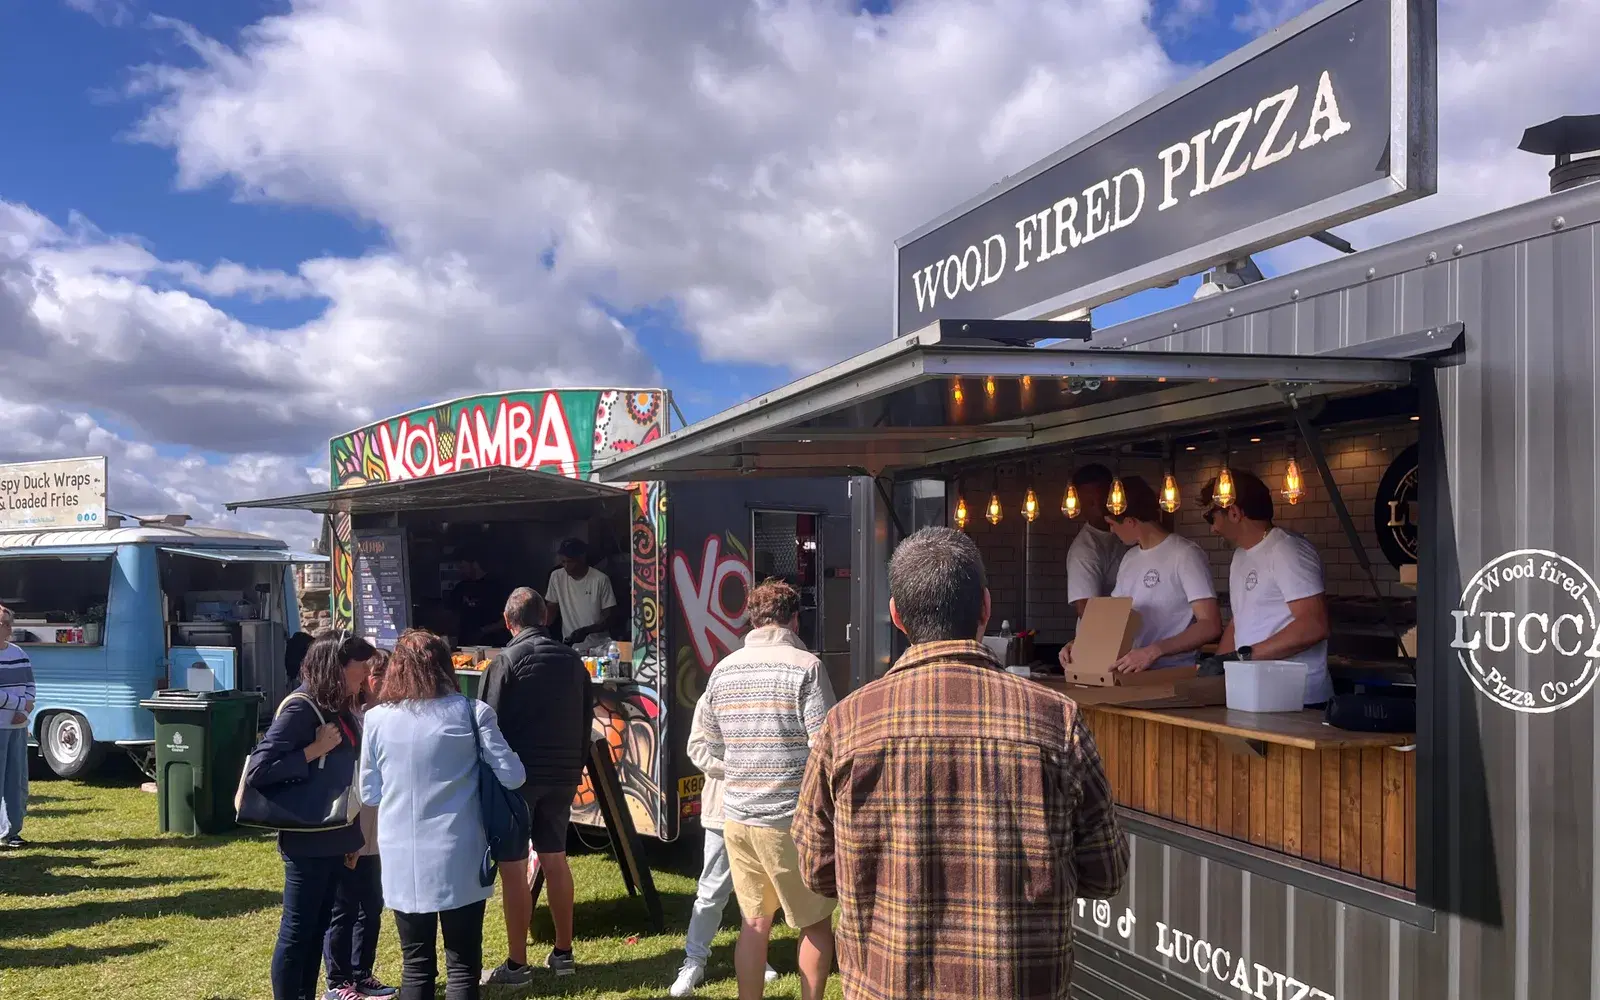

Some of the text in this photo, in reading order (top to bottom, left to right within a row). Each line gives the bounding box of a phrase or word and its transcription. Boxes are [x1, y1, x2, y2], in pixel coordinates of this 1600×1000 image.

[912, 70, 1352, 312] WOOD FIRED PIZZA
[378, 389, 580, 481] KOLAMBA
[0, 472, 91, 495] spy Duck Wraps
[9, 492, 48, 510] Loaded
[51, 492, 79, 508] Fries
[1476, 558, 1588, 600] Wood fired
[1482, 666, 1535, 706] Pizza
